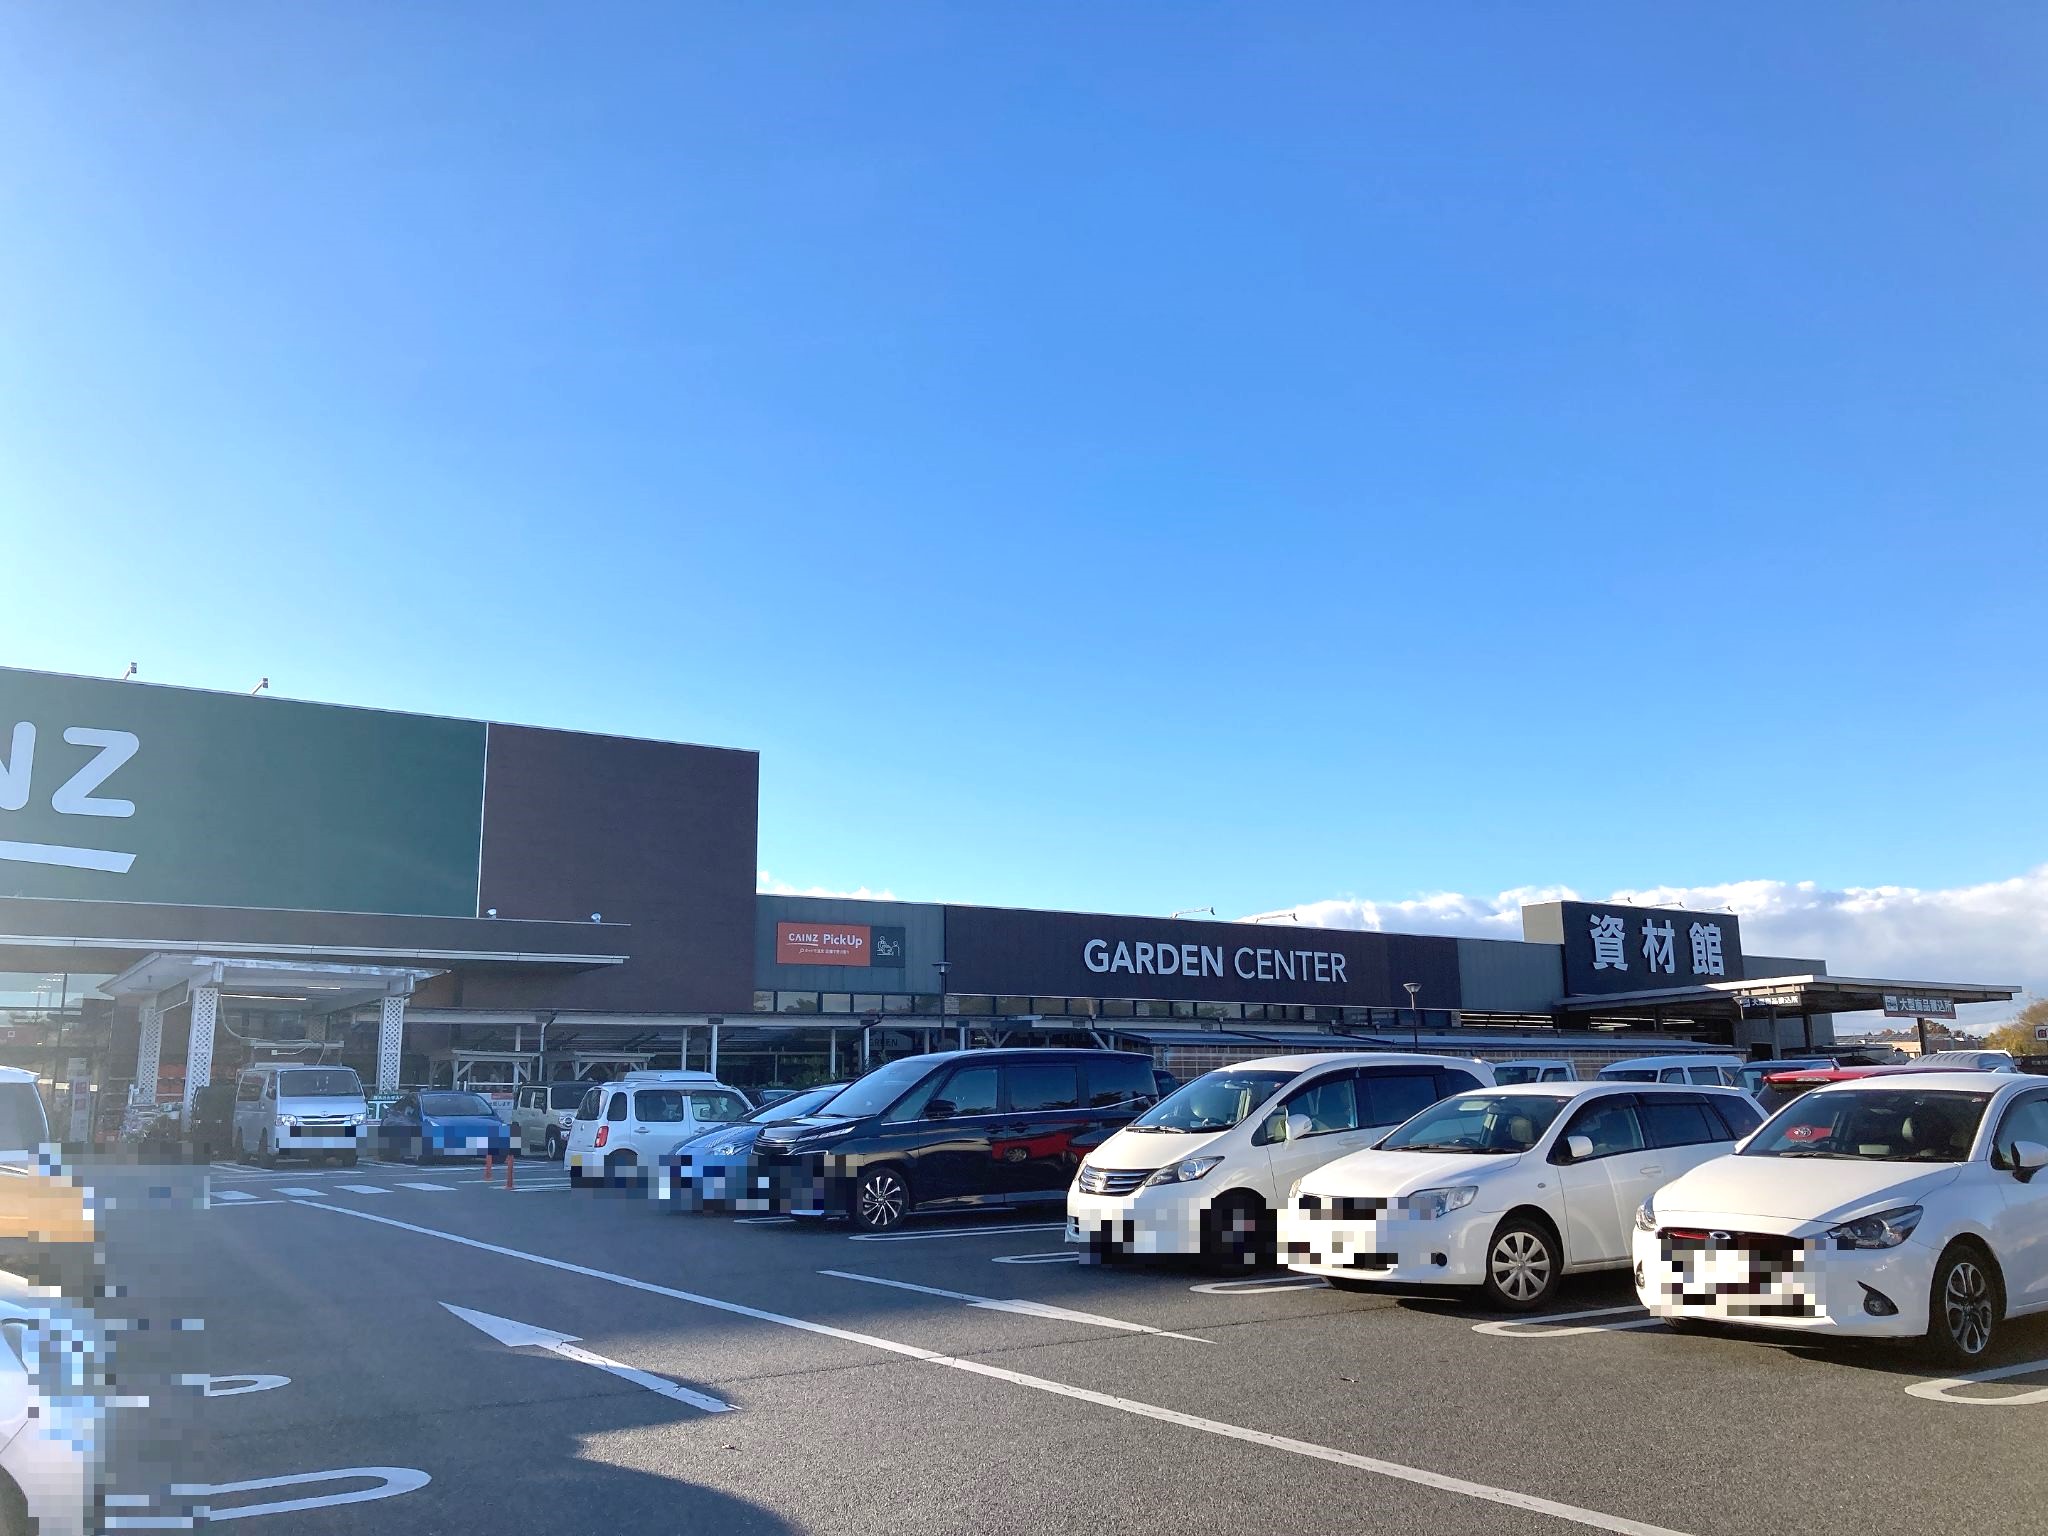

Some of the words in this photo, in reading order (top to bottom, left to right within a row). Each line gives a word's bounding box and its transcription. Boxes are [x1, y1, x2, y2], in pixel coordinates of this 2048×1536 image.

[788, 932, 819, 942] CAINZ
[1589, 914, 1725, 976] 資材館
[1083, 939, 1224, 977] GARDEN
[1234, 946, 1348, 983] CENTER
